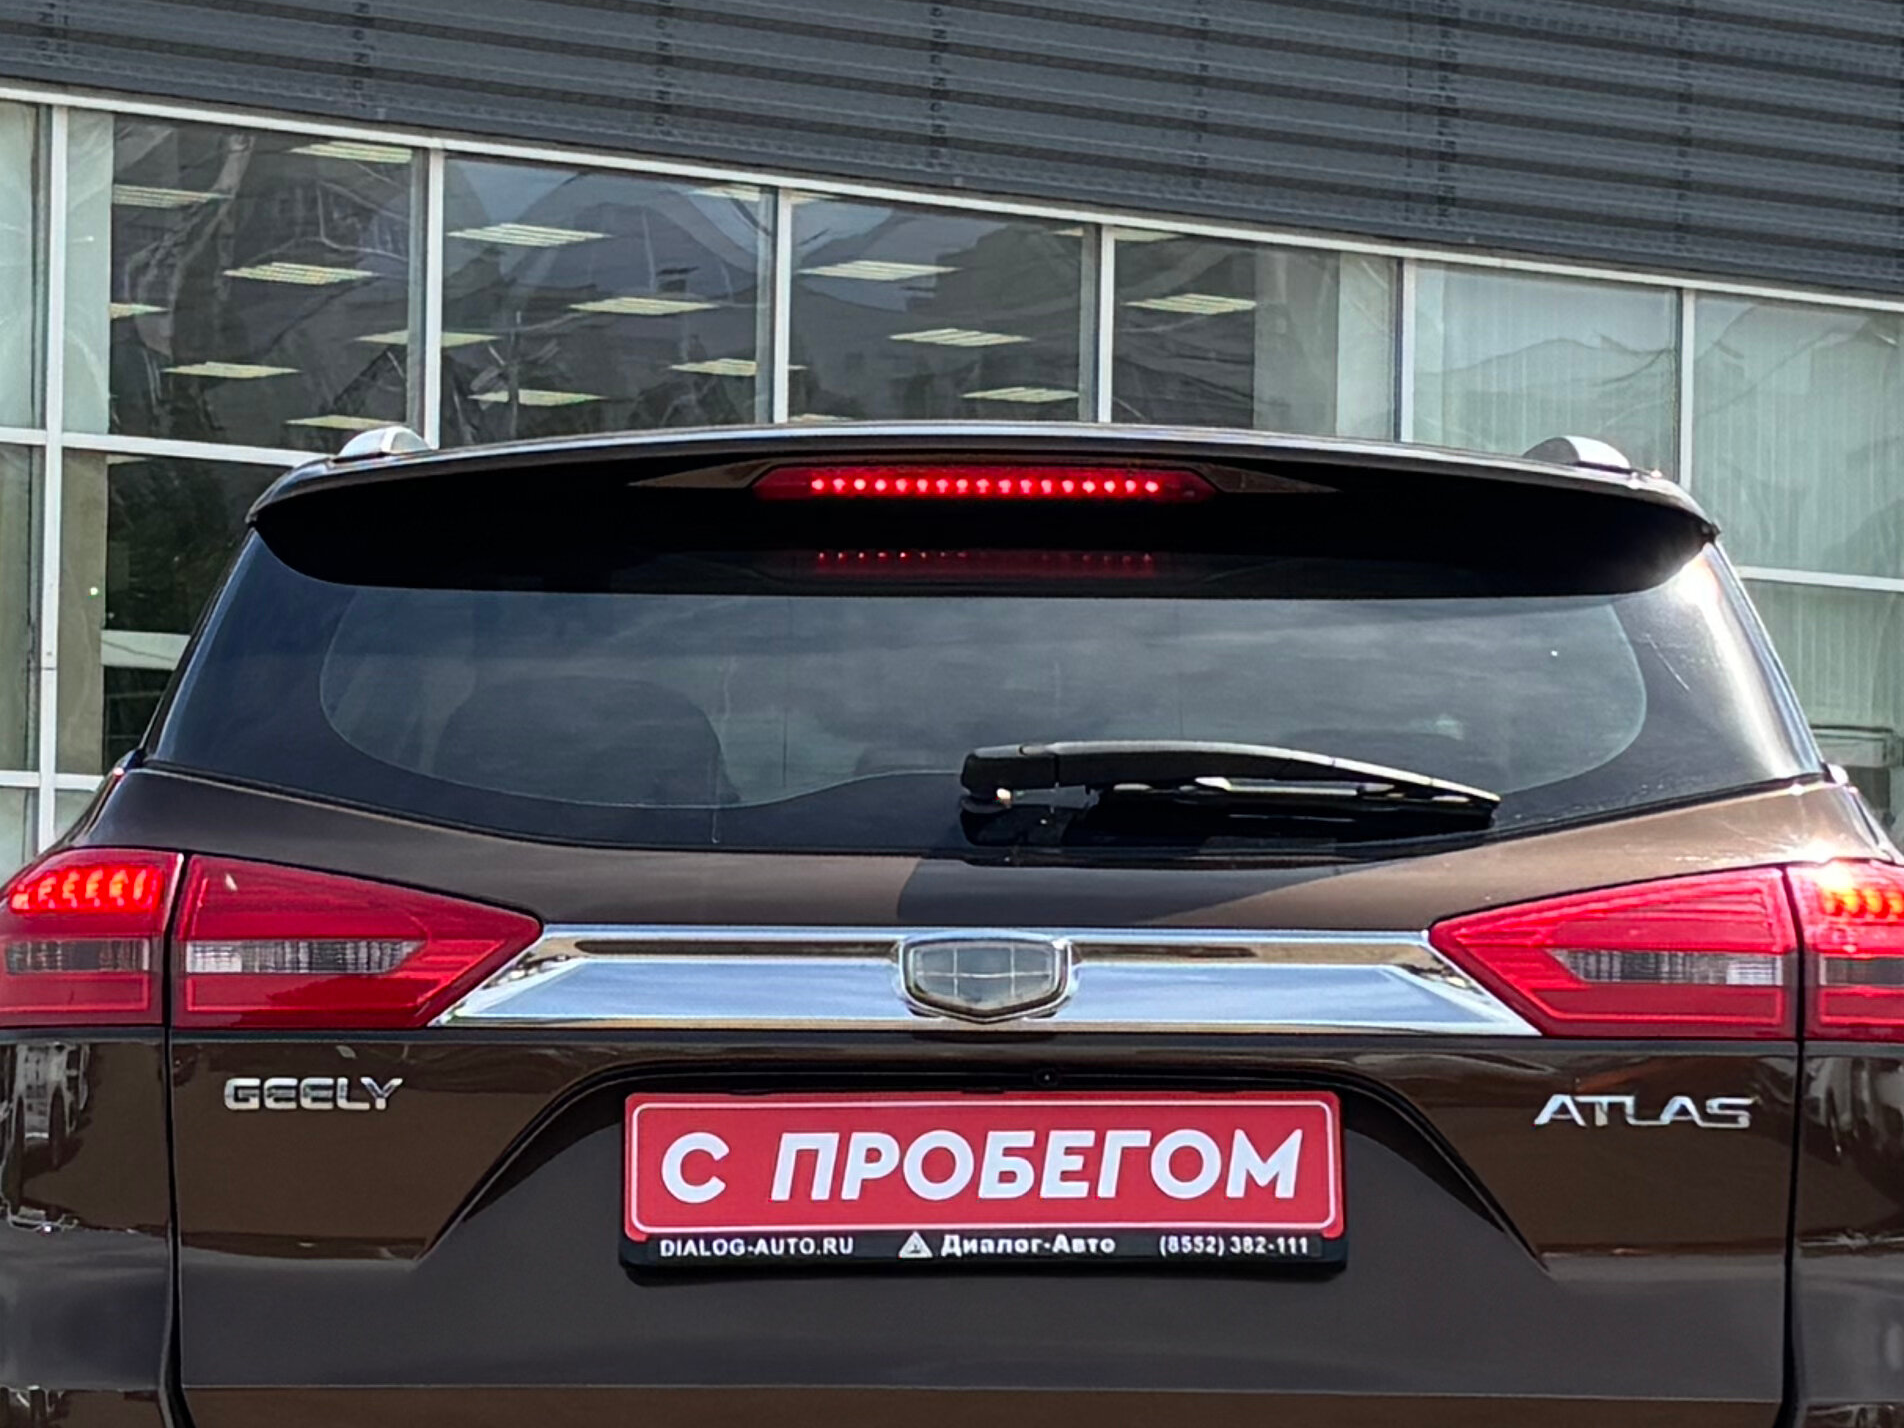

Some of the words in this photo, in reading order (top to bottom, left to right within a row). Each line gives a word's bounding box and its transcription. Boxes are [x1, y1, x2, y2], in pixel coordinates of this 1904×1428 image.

[223, 1076, 404, 1111] GEELY
[1533, 1093, 1756, 1129] ATLAS
[661, 1131, 730, 1204] С
[770, 1128, 1303, 1202] ПРОБЕГОМ
[659, 1237, 854, 1258] DIALOG-AUTO.RU
[940, 1234, 1116, 1258] Диалог-Авто
[1158, 1235, 1225, 1258] (8552)
[1229, 1235, 1310, 1256] 382-111
